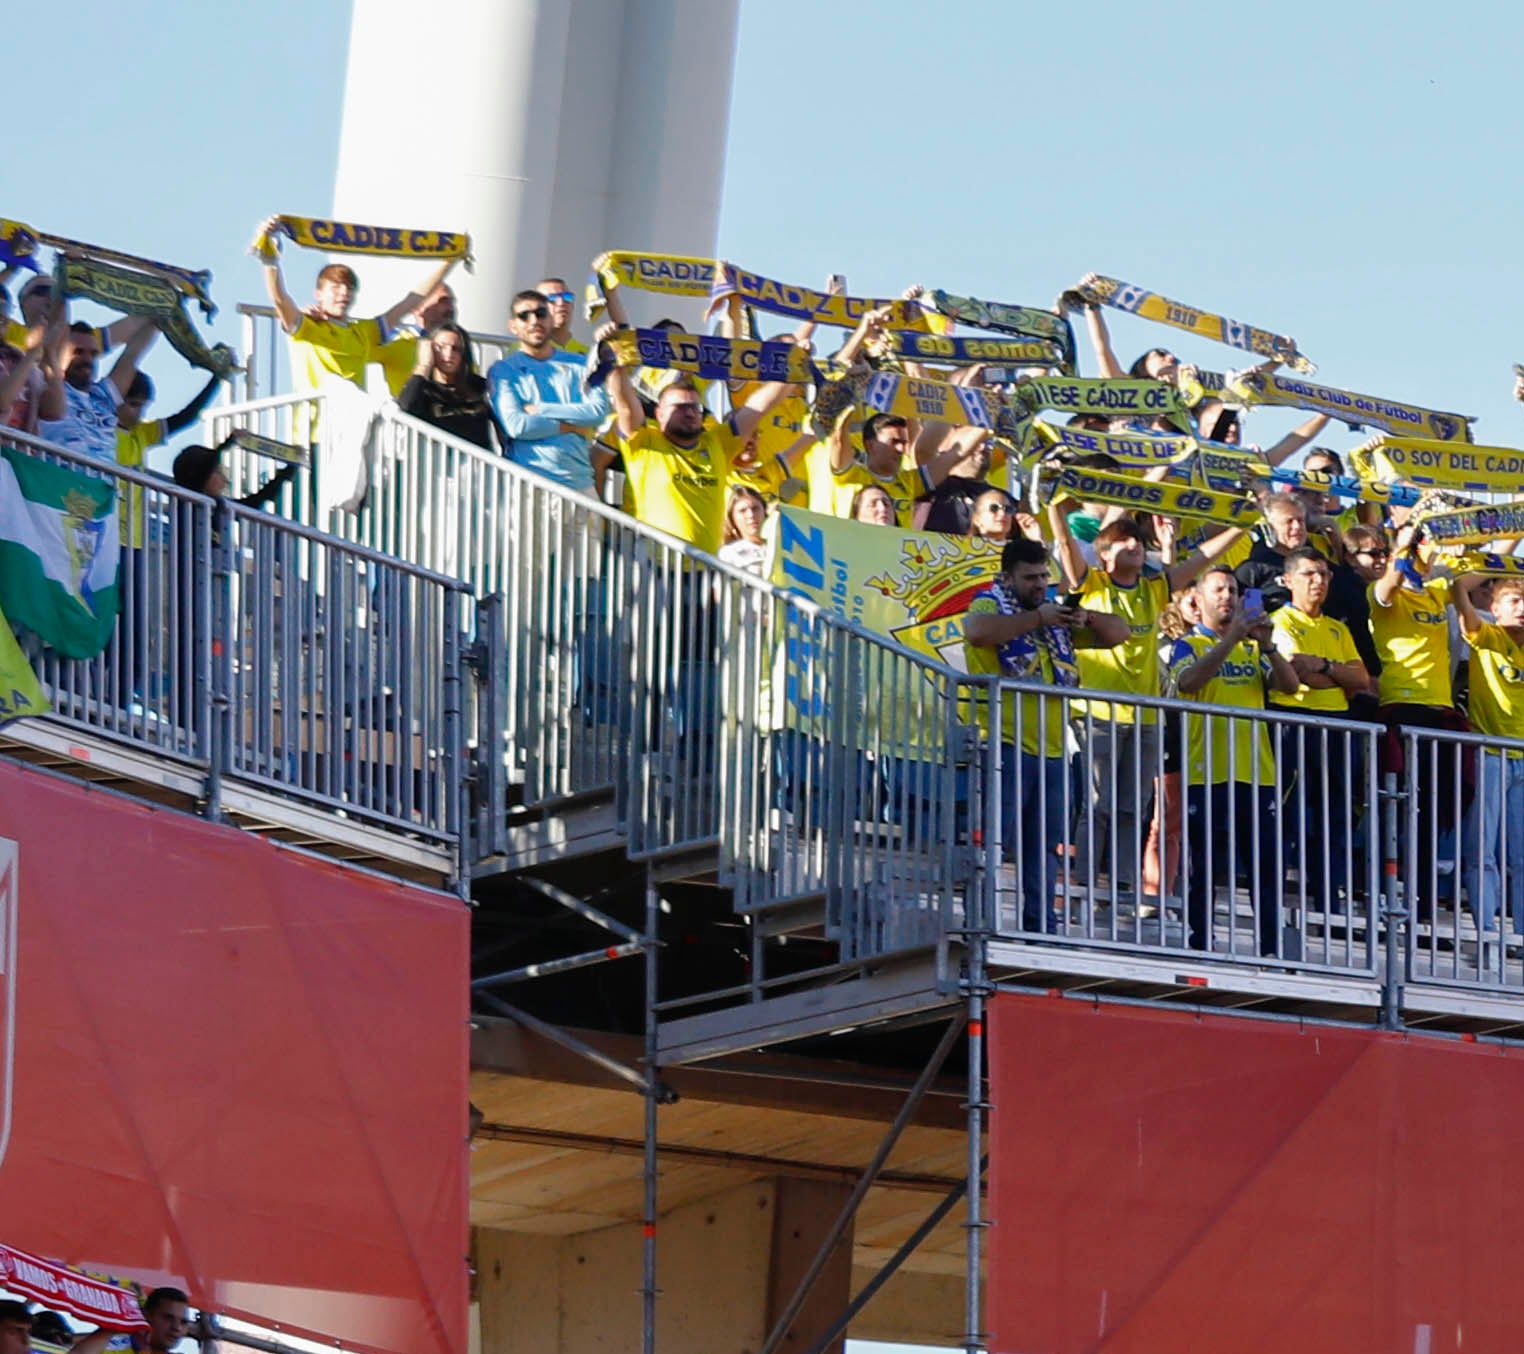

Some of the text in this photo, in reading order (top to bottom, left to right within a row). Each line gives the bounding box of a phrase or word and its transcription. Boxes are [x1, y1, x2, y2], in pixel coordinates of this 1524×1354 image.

[639, 258, 713, 282] CADIZ
[741, 275, 836, 321] CADIZ
[1062, 471, 1214, 510] Somos de
